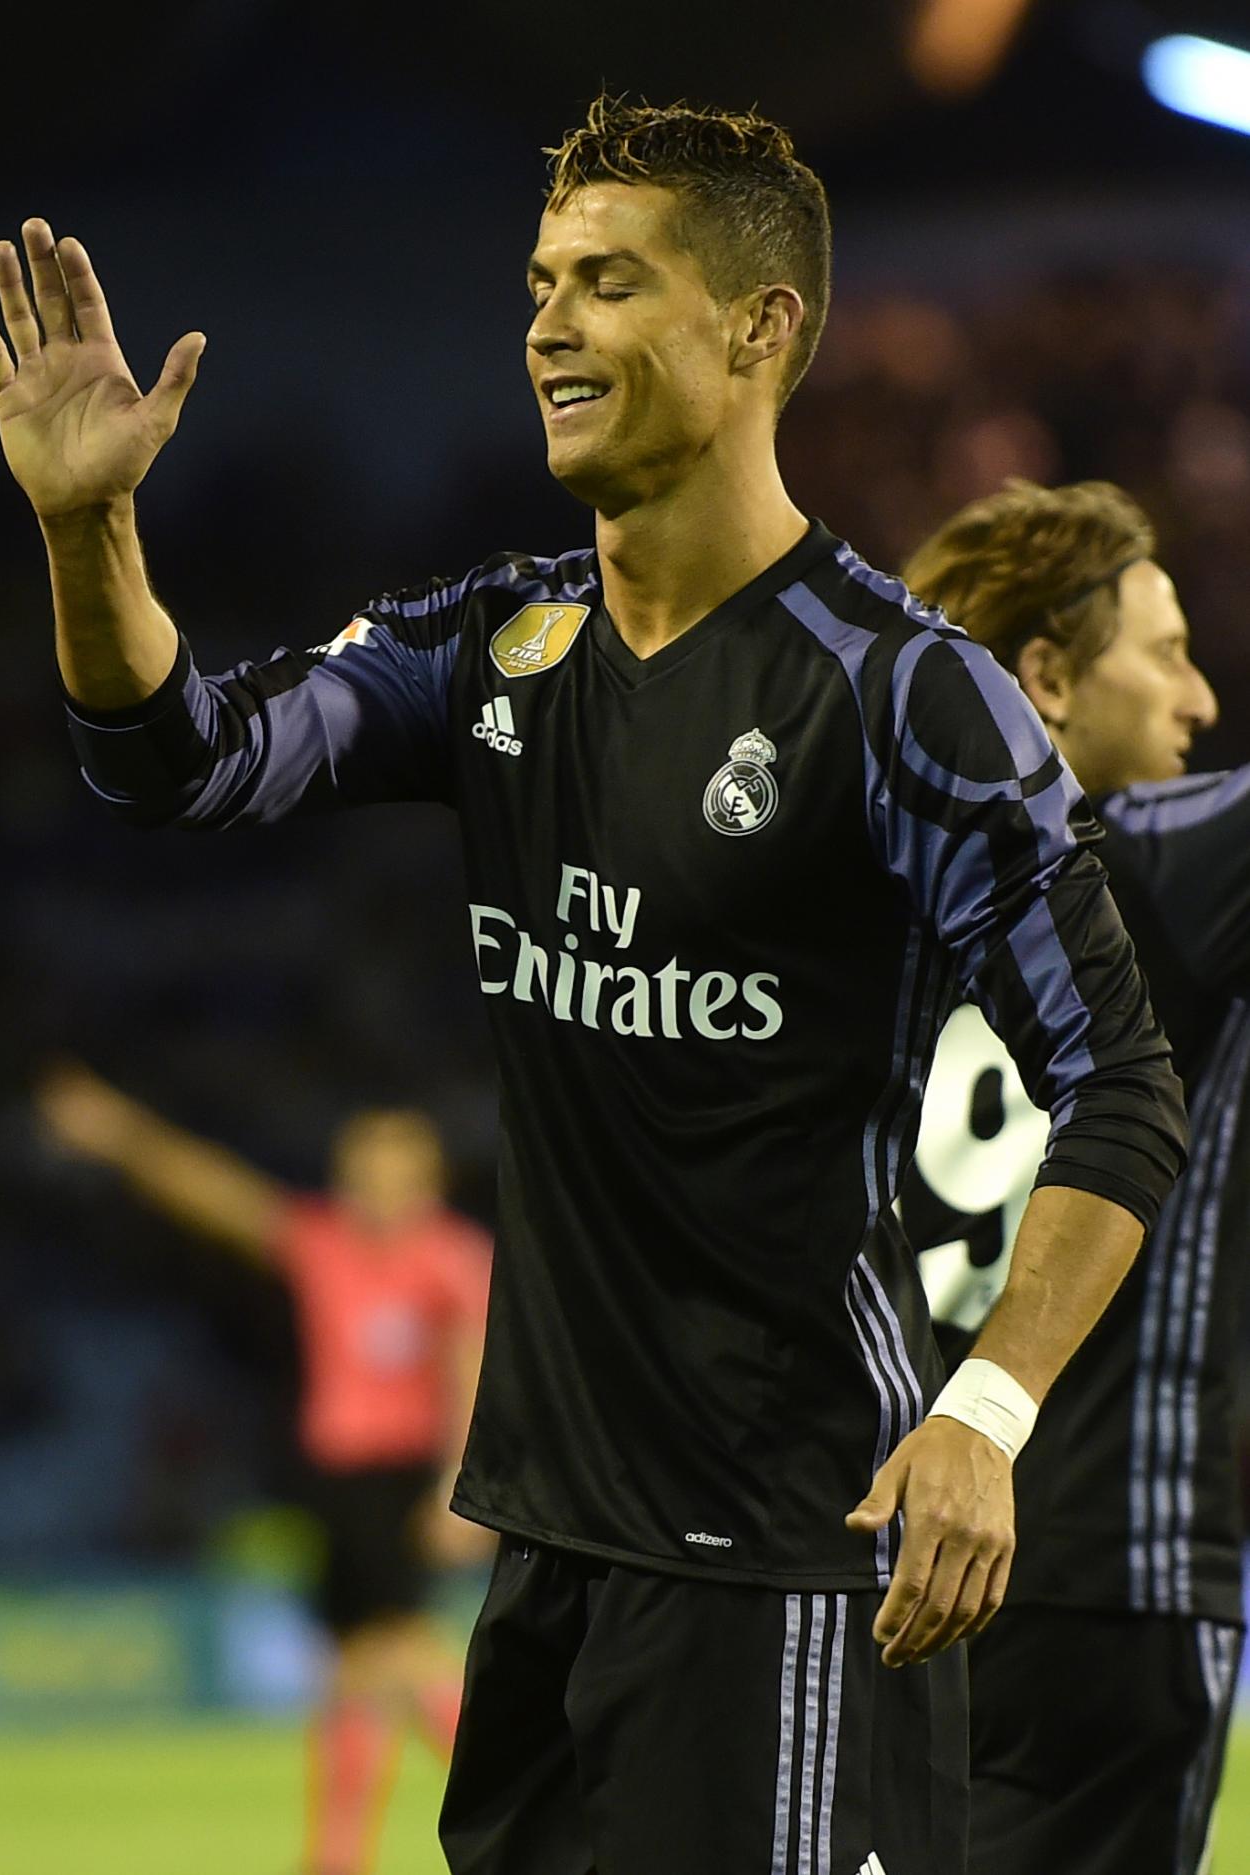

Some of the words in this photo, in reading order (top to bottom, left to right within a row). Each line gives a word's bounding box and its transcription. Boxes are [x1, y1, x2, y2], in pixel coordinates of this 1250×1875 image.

[508, 646, 543, 662] FIFA
[471, 721, 524, 756] adas
[556, 862, 642, 949] Fly
[890, 1002, 1052, 1333] 9
[684, 1531, 733, 1548] adizero
